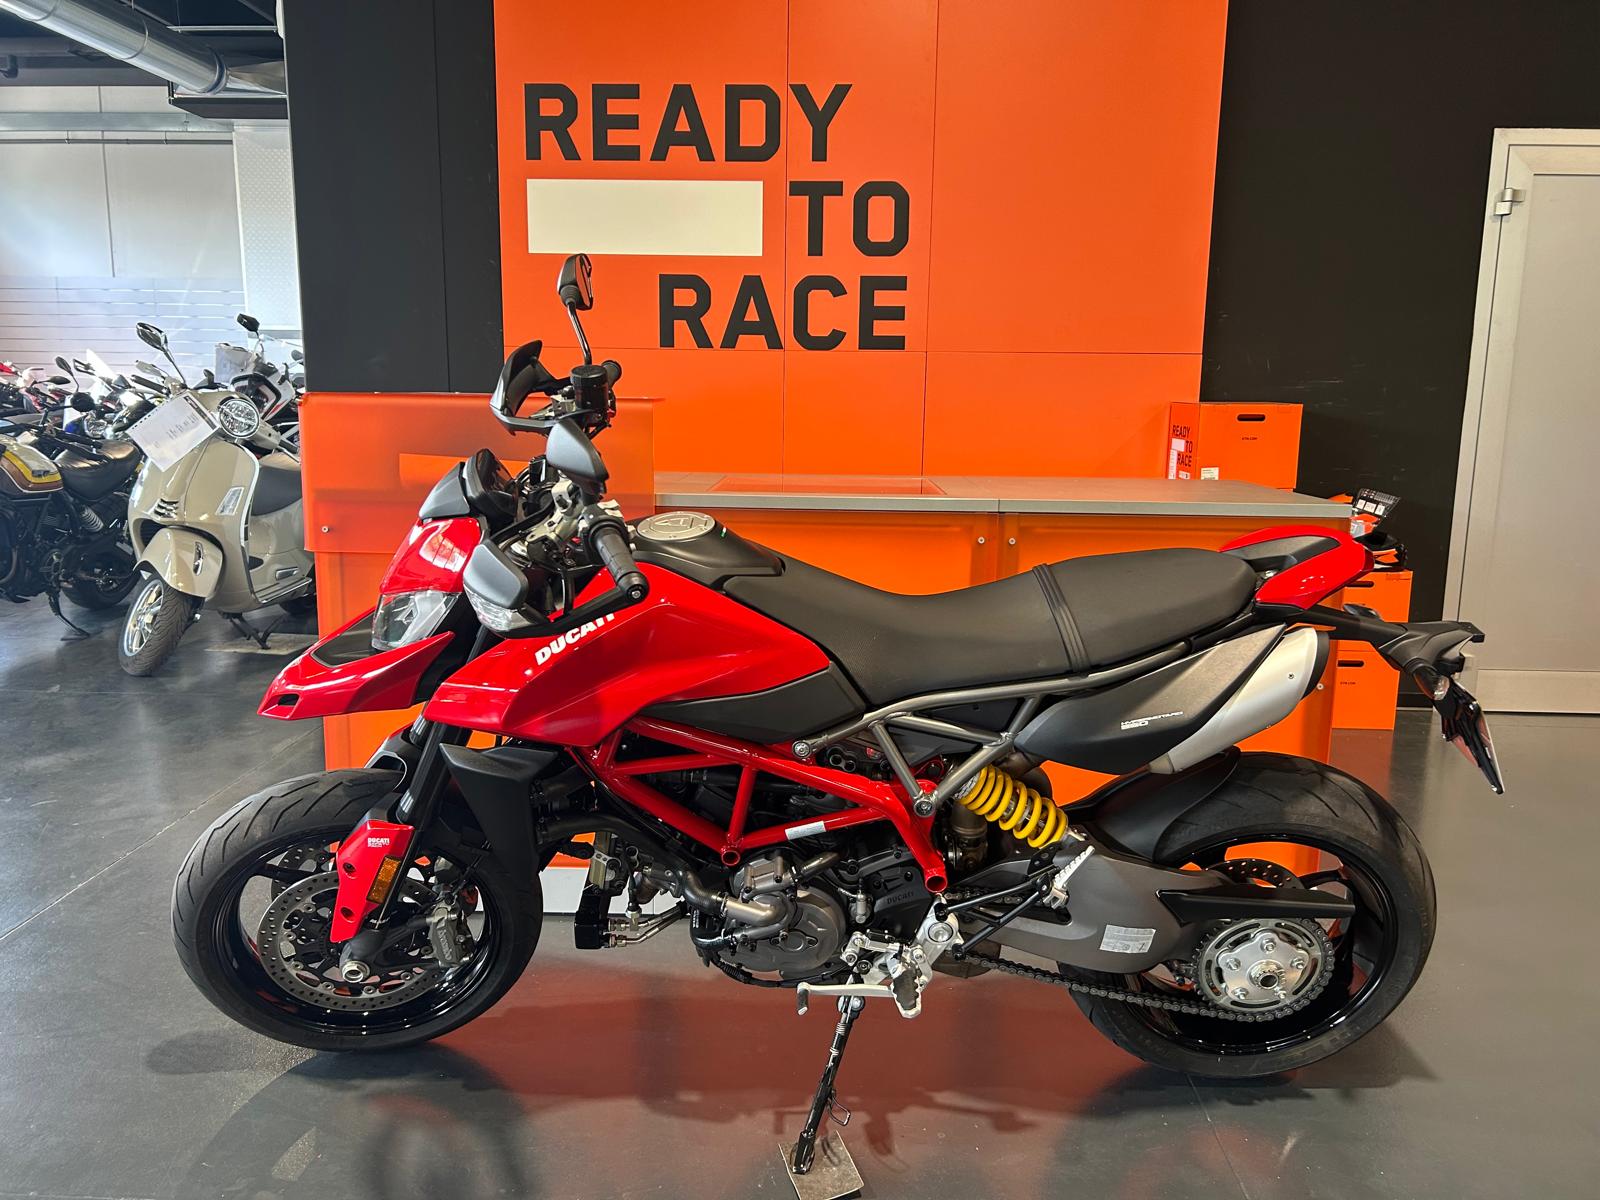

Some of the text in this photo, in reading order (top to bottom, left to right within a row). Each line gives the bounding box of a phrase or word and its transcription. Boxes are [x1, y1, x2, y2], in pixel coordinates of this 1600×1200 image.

[525, 83, 852, 162] READY
[789, 181, 909, 256] TO
[659, 274, 907, 350] RACE
[1172, 424, 1191, 438] READY
[1185, 440, 1193, 453] TO
[1177, 453, 1192, 467] RACE
